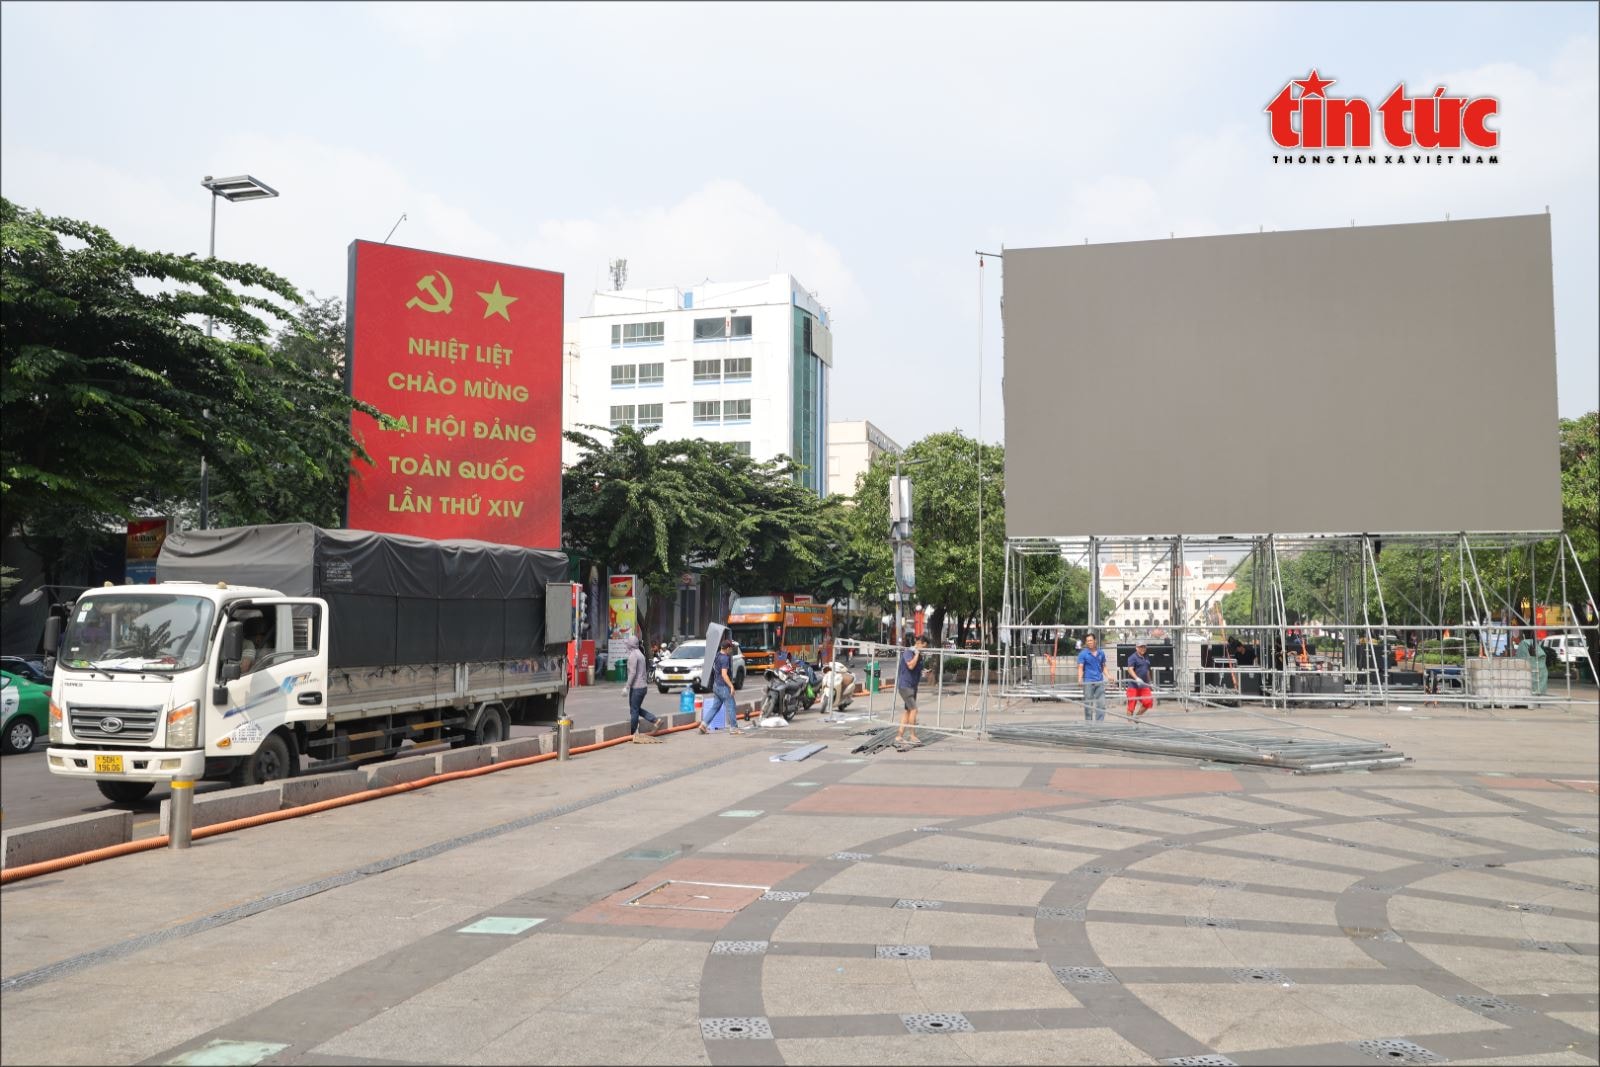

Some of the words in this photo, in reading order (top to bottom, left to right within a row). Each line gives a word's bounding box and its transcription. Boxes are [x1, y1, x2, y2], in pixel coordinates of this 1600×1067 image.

[408, 337, 470, 365] NHIỆT
[476, 344, 513, 368] LIỆT
[388, 371, 457, 396] CHÀO
[464, 378, 529, 403] MỪNG
[426, 415, 466, 441] HỘI
[473, 416, 537, 443] ĐẢNG
[388, 454, 451, 477] TOÀN
[458, 457, 525, 482] QUỐC
[388, 485, 432, 514] LẦN
[439, 492, 481, 516] THỨ
[487, 499, 524, 517] XIV
